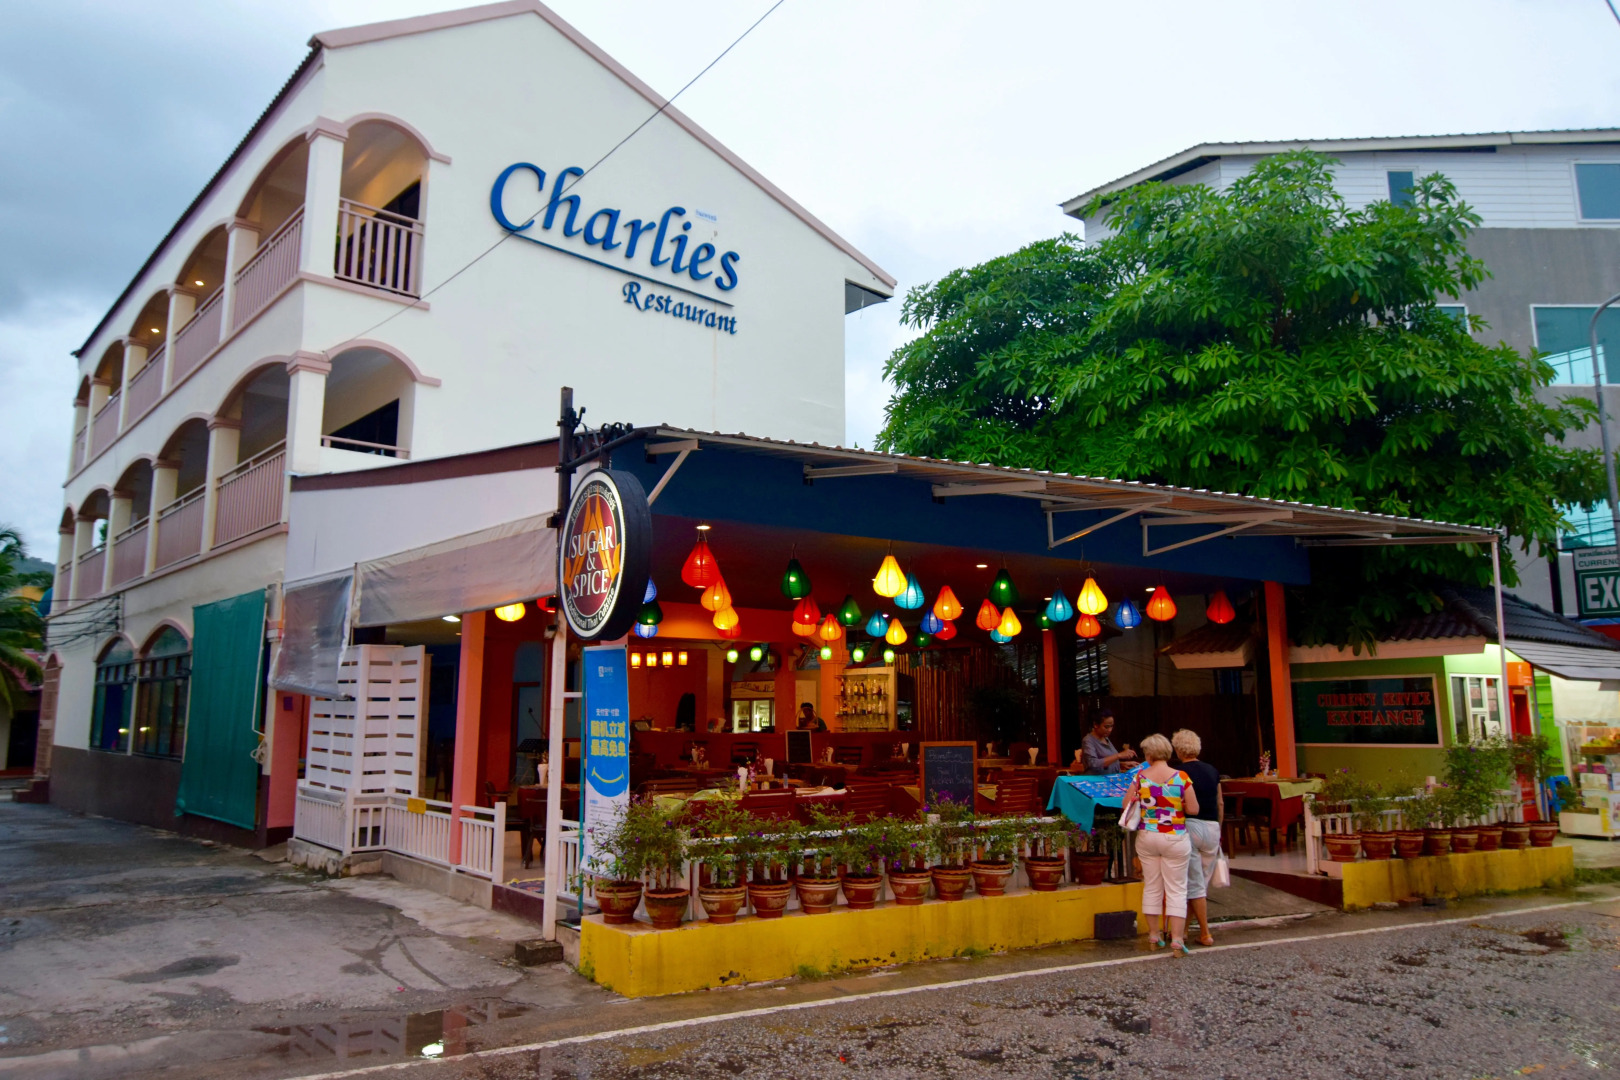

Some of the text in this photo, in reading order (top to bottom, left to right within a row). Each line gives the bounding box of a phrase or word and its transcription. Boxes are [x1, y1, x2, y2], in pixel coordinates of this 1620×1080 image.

[490, 162, 740, 291] Charlies
[622, 281, 738, 335] Restaurant
[571, 525, 615, 559] SUGAR
[586, 547, 596, 571] &
[573, 569, 609, 598] SPICE
[587, 614, 599, 629] Thai
[598, 587, 615, 621] Cuisine
[1317, 691, 1432, 707] CURRENCY SERVICE
[1327, 709, 1425, 726] EXCHANGE
